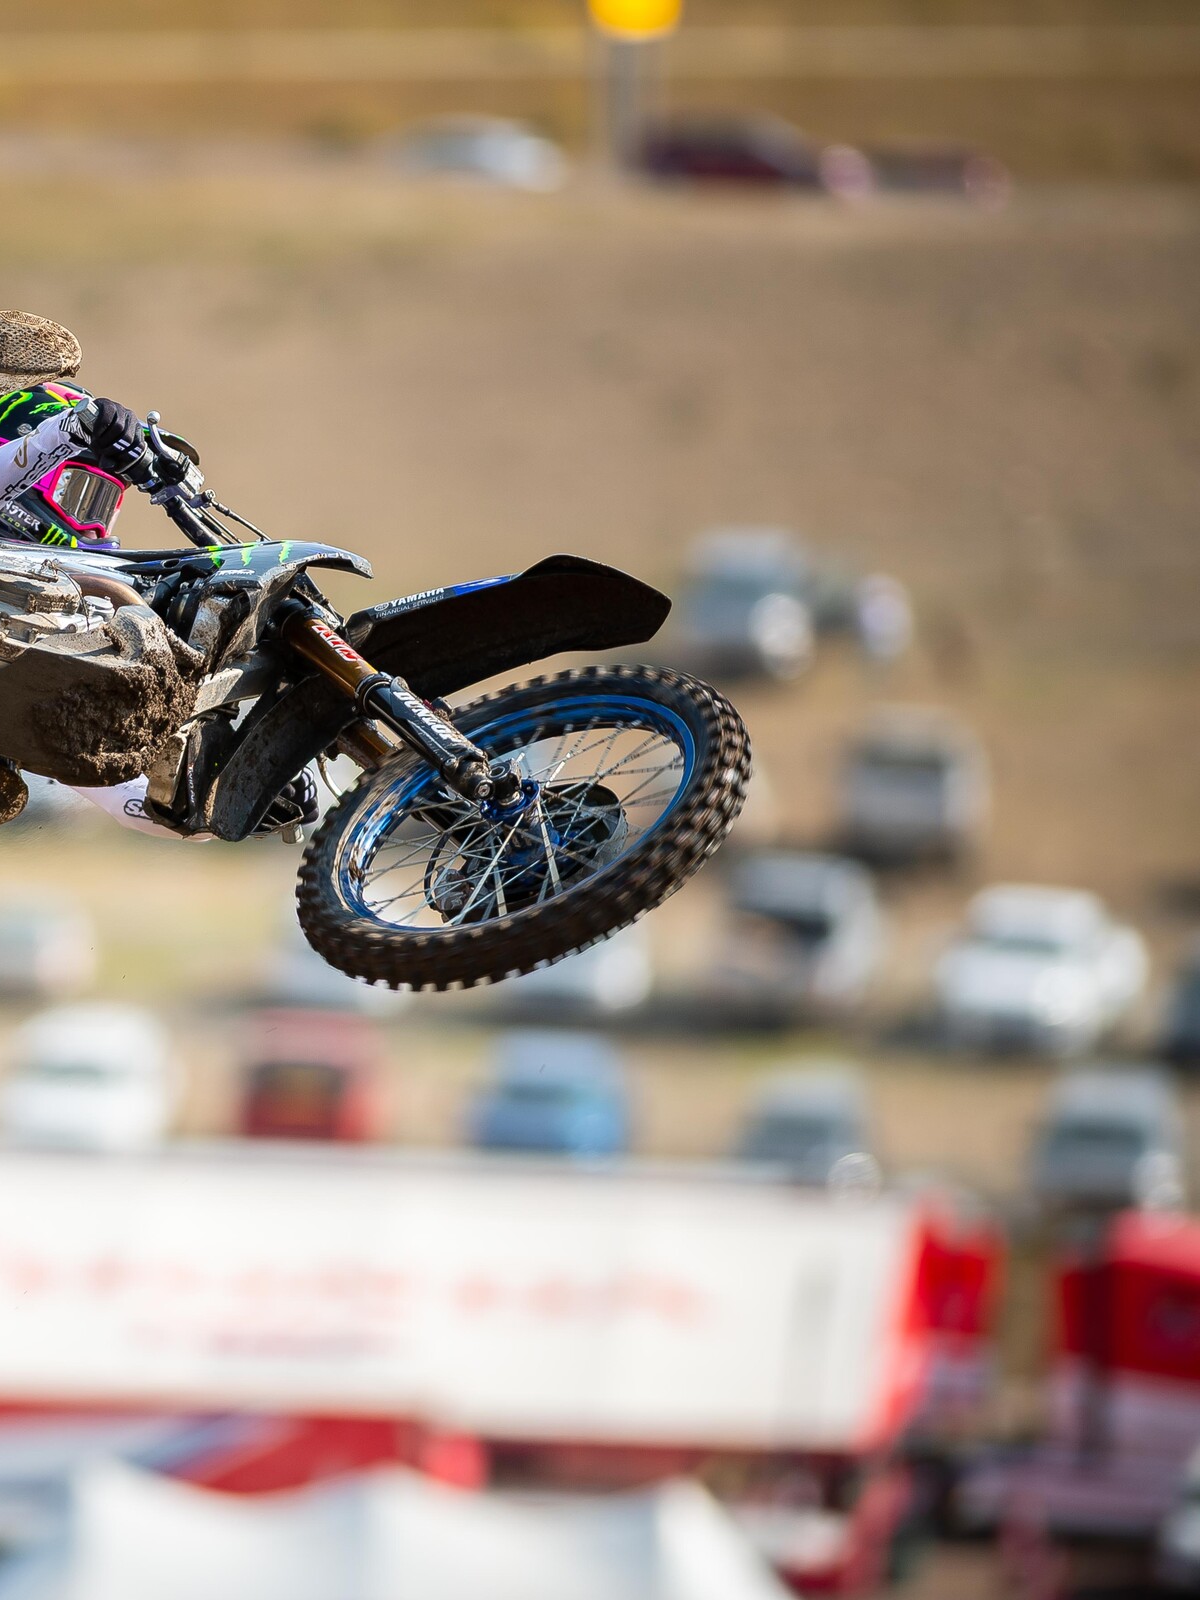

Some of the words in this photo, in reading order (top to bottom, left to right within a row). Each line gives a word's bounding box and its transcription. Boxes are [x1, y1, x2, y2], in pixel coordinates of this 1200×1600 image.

[4, 499, 41, 532] NSTER
[375, 604, 411, 619] FINANCIAL
[412, 594, 445, 608] SERVICES
[389, 587, 445, 607] YAMAHA
[393, 690, 461, 742] DUNLOP
